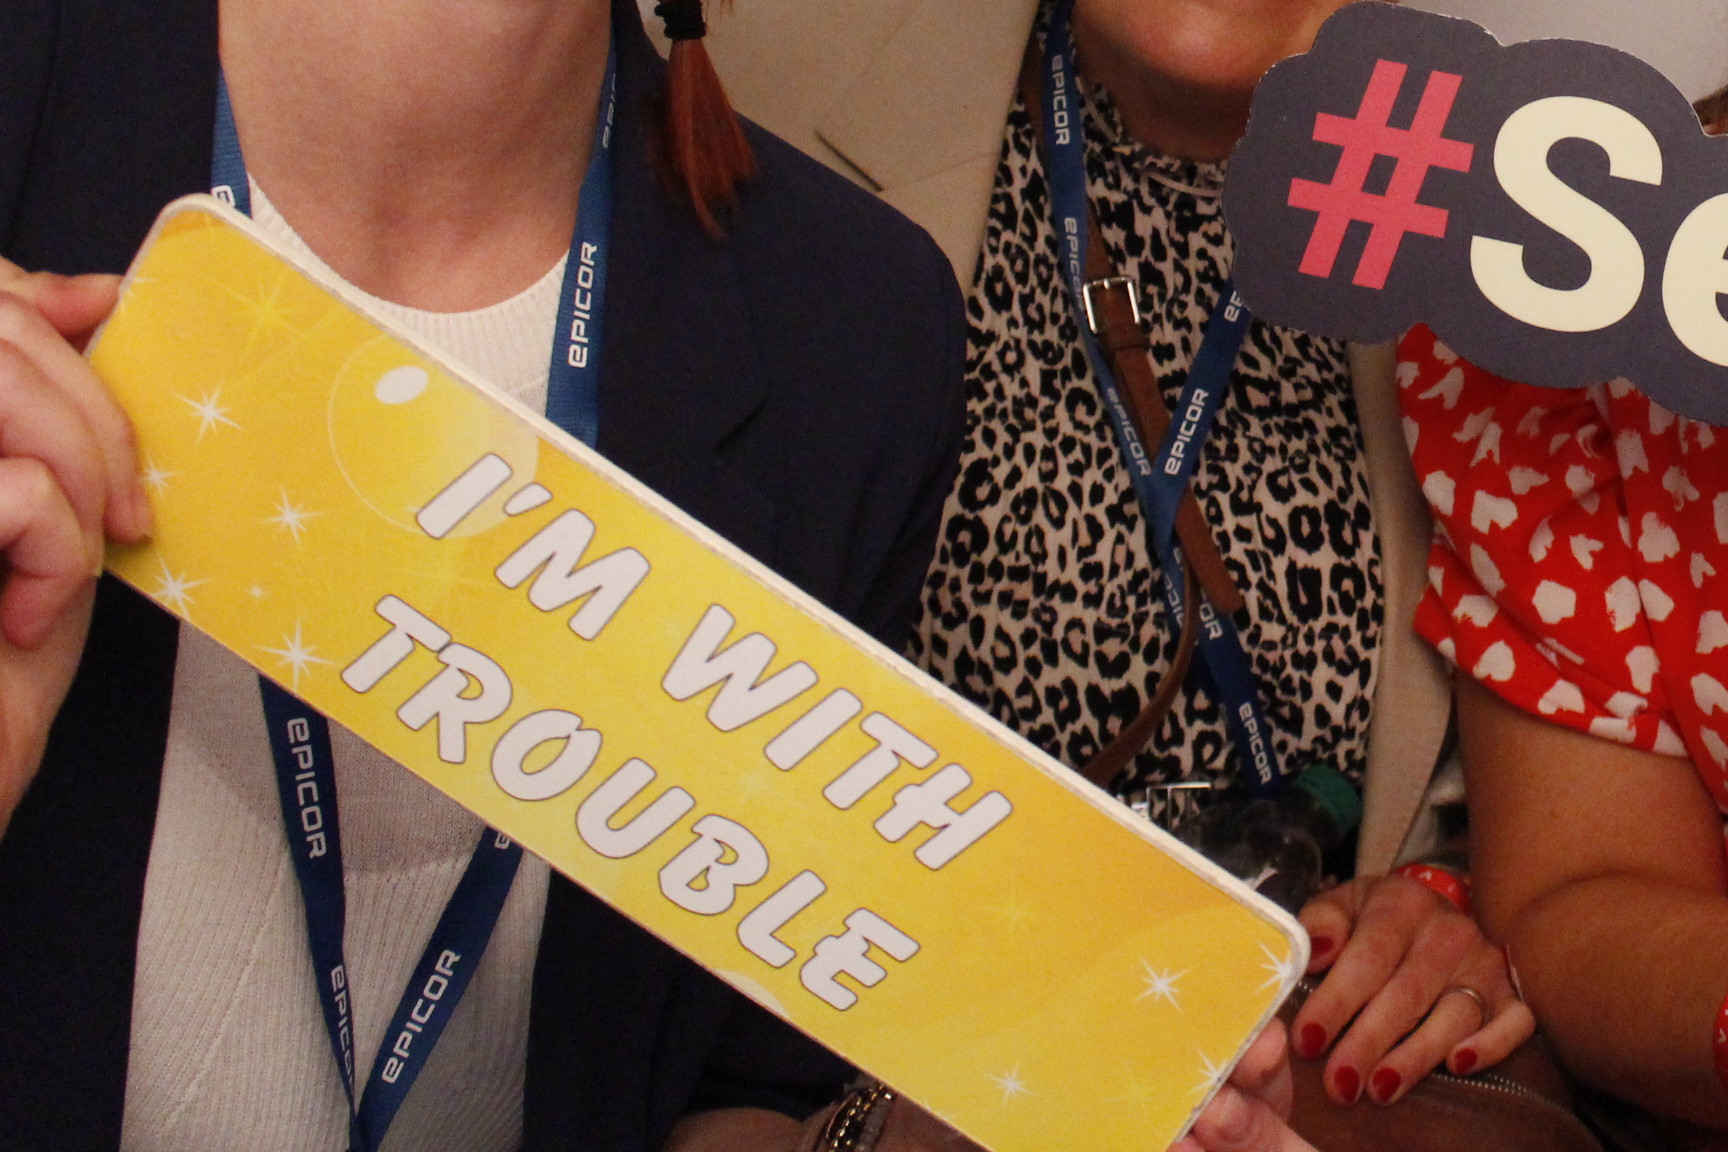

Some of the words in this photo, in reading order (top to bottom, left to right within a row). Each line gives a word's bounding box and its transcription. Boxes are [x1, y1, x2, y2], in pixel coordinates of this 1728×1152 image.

[341, 594, 920, 1011] TROUBLE
[417, 453, 650, 641] I'M
[662, 604, 1013, 870] WITH
